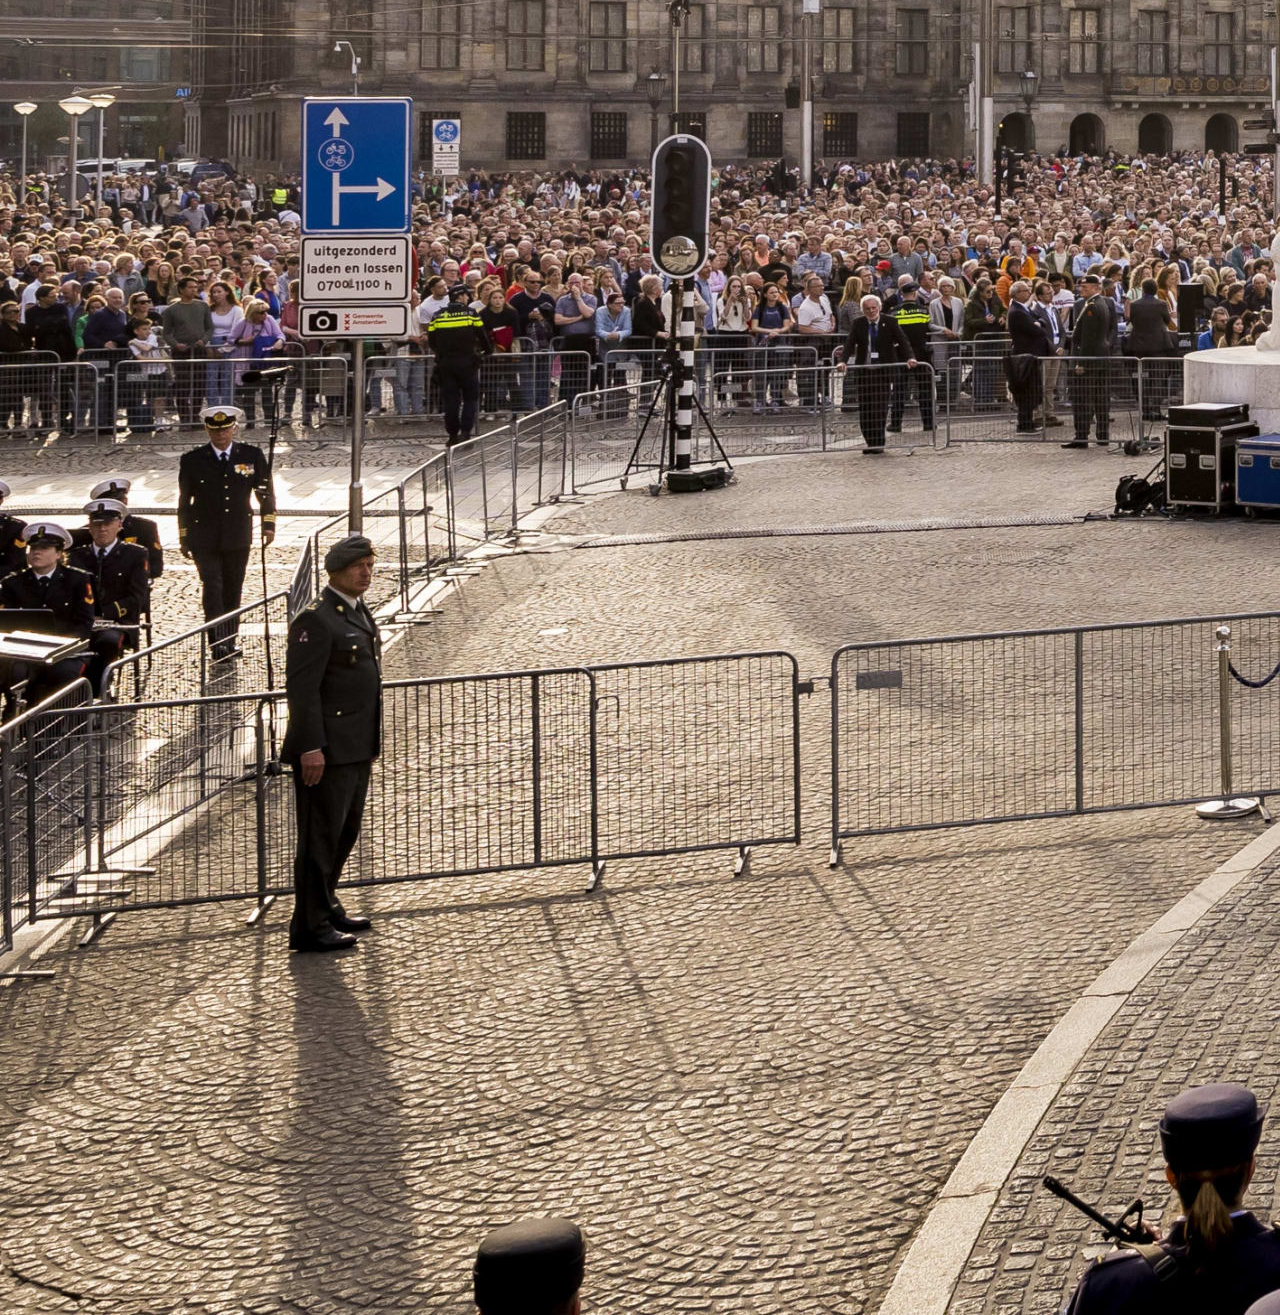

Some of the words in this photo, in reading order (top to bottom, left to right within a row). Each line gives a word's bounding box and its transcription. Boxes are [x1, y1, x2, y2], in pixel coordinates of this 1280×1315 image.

[314, 245, 396, 259] uitgezonderd
[307, 263, 341, 274] laden
[344, 265, 360, 273] en
[363, 263, 403, 273] lossen
[384, 281, 392, 291] h
